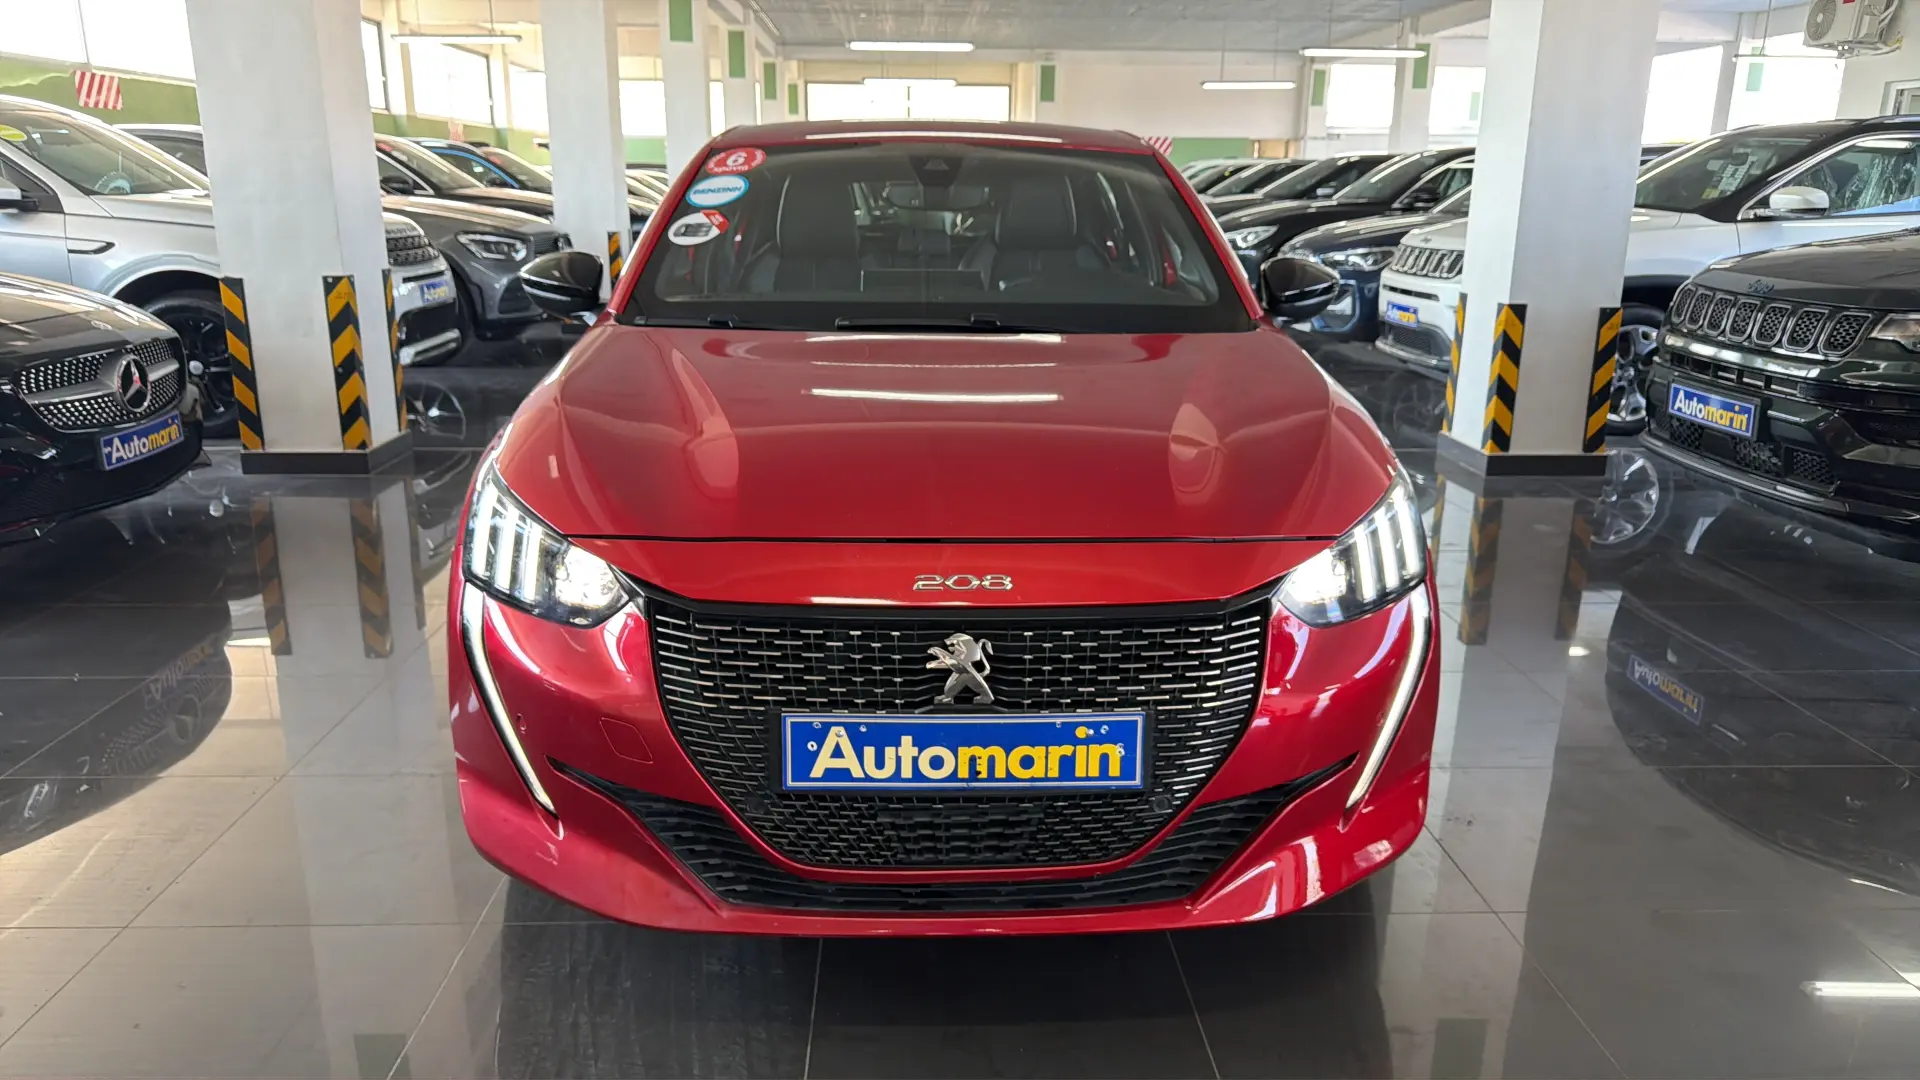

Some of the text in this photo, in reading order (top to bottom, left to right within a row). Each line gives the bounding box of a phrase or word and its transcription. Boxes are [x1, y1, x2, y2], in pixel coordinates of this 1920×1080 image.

[726, 151, 748, 167] 6
[1673, 389, 1749, 431] Automarin
[111, 418, 179, 464] Automarin
[912, 573, 1013, 591] 208
[809, 725, 1124, 780] Automarin
